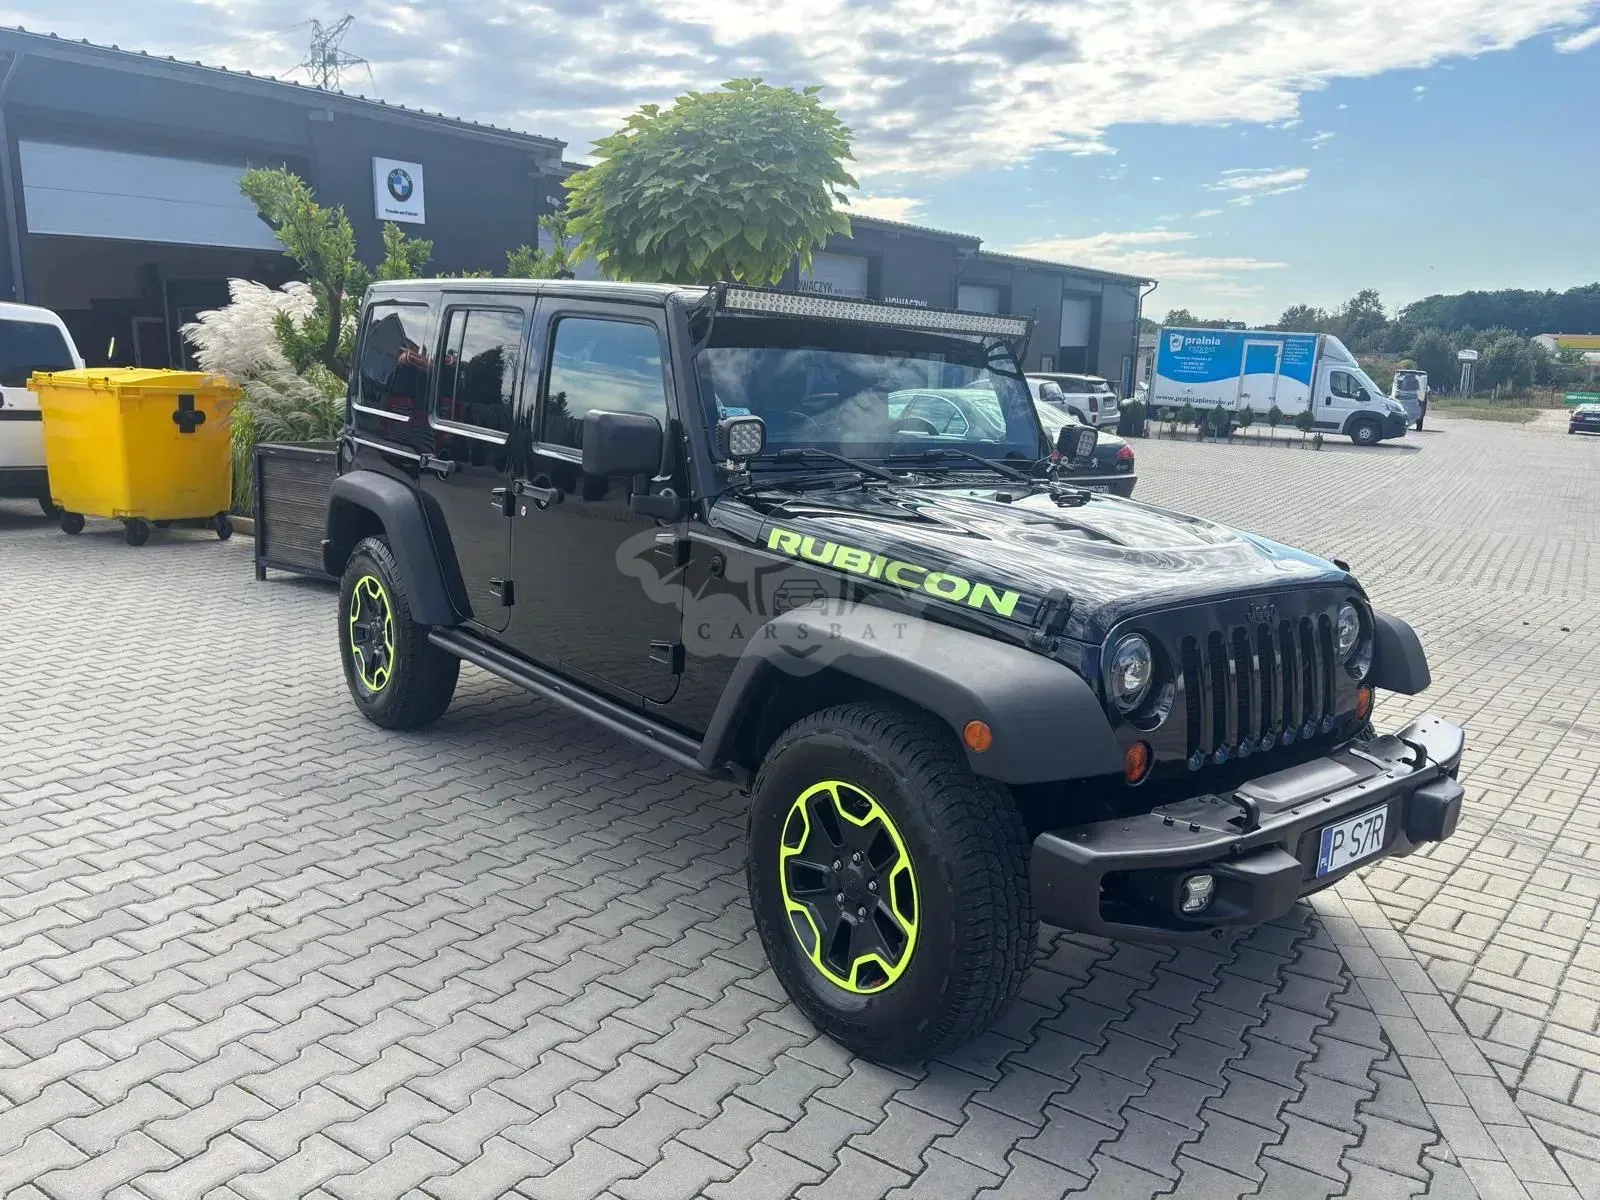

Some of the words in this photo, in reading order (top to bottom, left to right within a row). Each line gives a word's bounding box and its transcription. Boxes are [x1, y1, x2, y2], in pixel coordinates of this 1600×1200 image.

[1184, 336, 1221, 346] pralnia
[767, 528, 1020, 617] RUBICON
[1330, 829, 1345, 867] P
[1349, 813, 1384, 858] S7R
